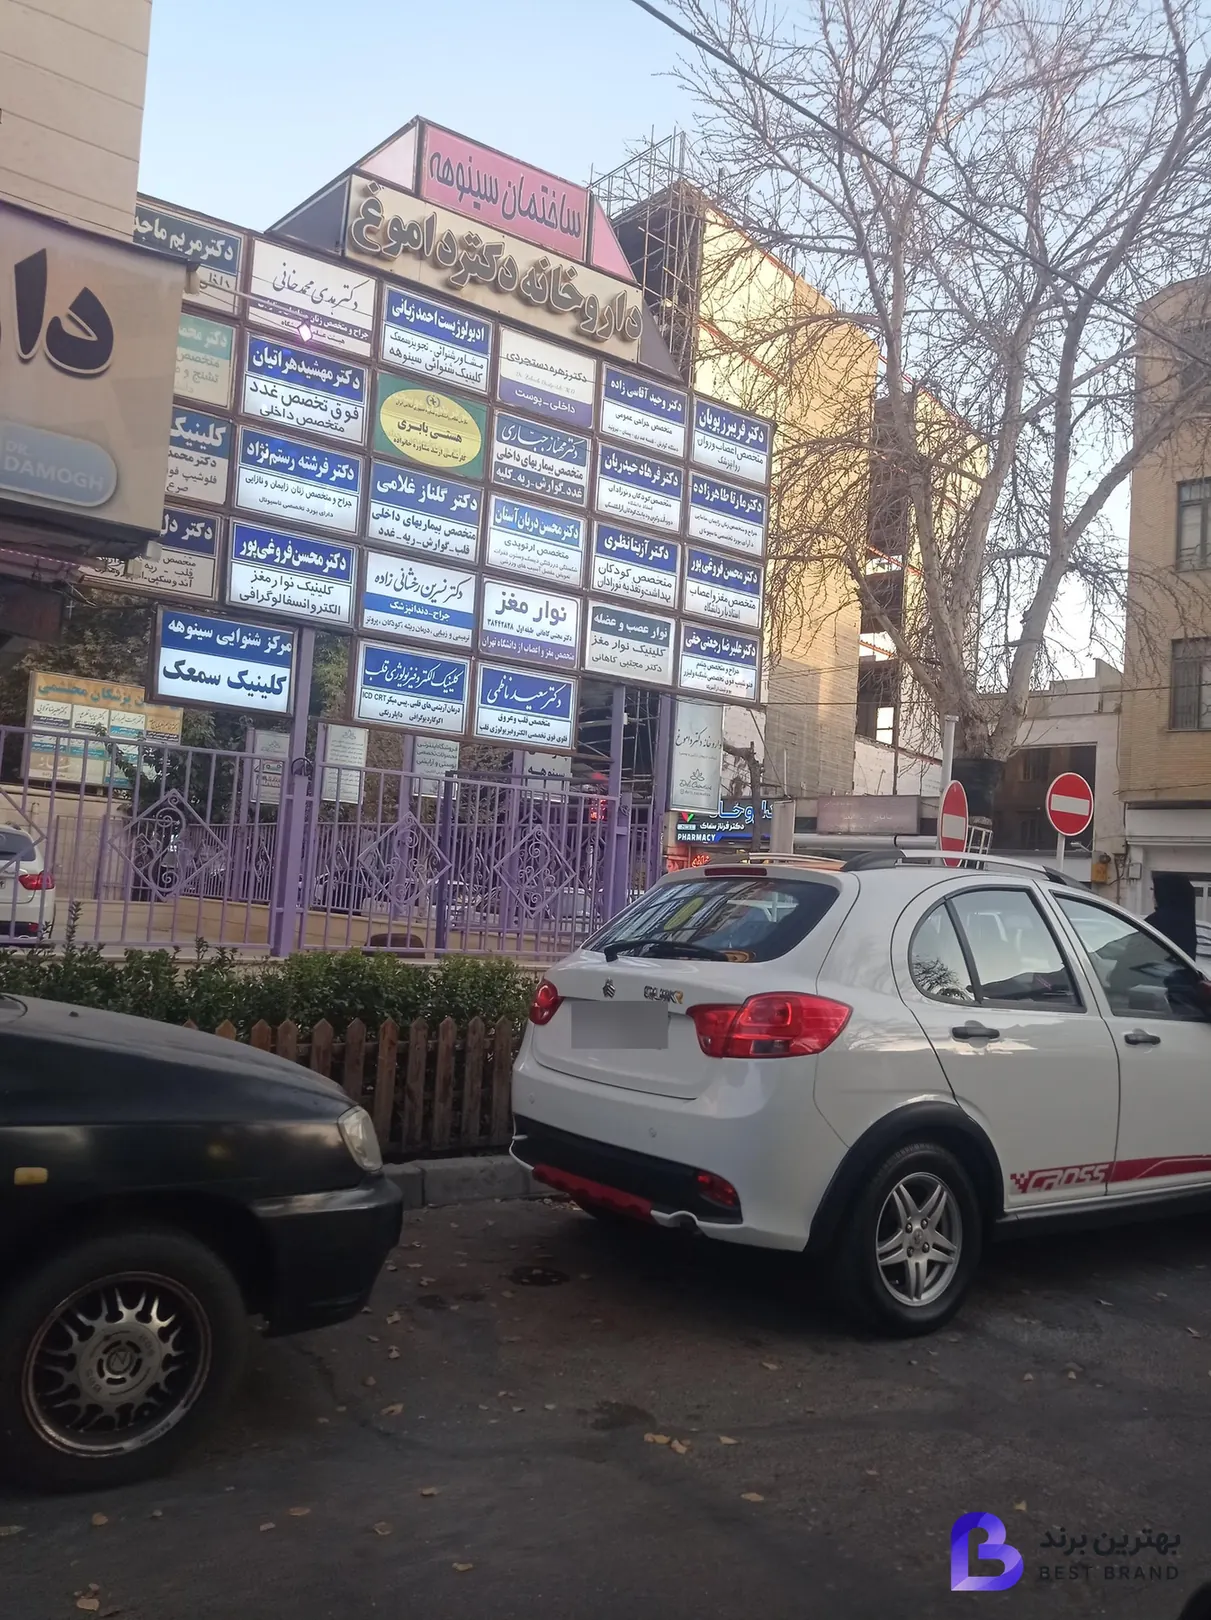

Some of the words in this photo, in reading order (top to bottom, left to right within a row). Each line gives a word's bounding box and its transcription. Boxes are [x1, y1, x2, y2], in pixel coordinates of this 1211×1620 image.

[429, 150, 500, 211] سینوهه
[501, 172, 581, 238] ساختمان
[352, 181, 459, 265] داموغ
[450, 232, 519, 290] دکتر
[330, 279, 371, 316] دکتر
[518, 255, 643, 341] داروخانه
[391, 298, 417, 322] ژیانی
[415, 307, 437, 325] احمد
[309, 313, 325, 326] زنان
[324, 320, 348, 332] متخصص
[353, 328, 369, 340] جراح
[437, 316, 484, 342] ادیولوژیست
[252, 347, 299, 374] هراتیان
[387, 346, 422, 366] سینوهه
[504, 352, 550, 371] دستجردی
[297, 360, 333, 382] مهشید
[424, 357, 454, 375] شنوائی
[548, 365, 569, 380] زهره
[331, 369, 360, 389] دکتر
[454, 367, 483, 384] کلینیک
[567, 371, 588, 383] دکتر
[249, 380, 278, 398] غدد
[610, 379, 626, 395] زاده
[280, 394, 328, 412] تخصص
[514, 389, 542, 406] پوست
[649, 393, 666, 410] وحید
[666, 399, 682, 412] دکتر
[259, 404, 294, 420] داخلی
[330, 402, 359, 423] فوق
[549, 400, 575, 413] داخلی
[295, 416, 345, 433] متخصص
[397, 419, 428, 436] بابری
[698, 407, 720, 433] پویان
[718, 416, 746, 440] فریبرز
[169, 416, 227, 448] کلینیک
[429, 429, 462, 443] هستی
[744, 425, 764, 444] دکتر
[193, 455, 217, 468] دکتر
[496, 447, 522, 463] داخلی
[520, 454, 554, 472] بیماریهای
[604, 452, 638, 475] حیدریان
[3, 456, 105, 493] DAMOGH
[244, 474, 264, 485] نازایی
[495, 466, 514, 480] کلیه
[516, 473, 530, 488] ریه
[553, 467, 583, 480] متخصص
[638, 462, 660, 483] فرهاد
[659, 471, 678, 487] دکتر
[165, 481, 188, 494] صرع
[269, 479, 289, 492] زایمان
[290, 485, 304, 496] زنان
[376, 474, 415, 494] غلامی
[534, 476, 563, 495] گوارش
[565, 486, 582, 498] غدد
[258, 496, 282, 506] ناسیونال
[305, 491, 331, 502] متخصص
[417, 483, 448, 503] گلناز
[281, 499, 305, 514] تخصصی
[336, 497, 352, 508] جراح
[449, 493, 477, 511] دکتر
[305, 507, 320, 516] بورد
[318, 510, 334, 518] دارای
[371, 507, 400, 522] داخلی
[492, 501, 520, 528] آستان
[377, 526, 395, 537] غدد
[402, 514, 442, 534] بیماریهای
[538, 521, 562, 535] محسن
[402, 532, 415, 546] ریه
[443, 527, 477, 544] متخصص
[559, 524, 580, 543] دکتر
[454, 544, 470, 556] قلب
[503, 539, 535, 552] ارتوپدی
[604, 534, 632, 551] نظری
[630, 537, 651, 560] آزیتا
[162, 555, 196, 567] متخصص
[290, 549, 323, 566] محسن
[536, 548, 569, 560] متخصص
[648, 545, 669, 560] دکتر
[143, 562, 157, 574] ریه
[321, 552, 346, 573] دکتر
[597, 562, 632, 580] کودکان
[173, 567, 194, 580] قلب
[250, 569, 271, 583] مغز
[374, 571, 393, 587] زاده
[391, 567, 422, 594] رخشانی
[632, 575, 672, 588] متخصص
[270, 575, 294, 591] نوار
[296, 580, 334, 597] کلینیک
[418, 578, 448, 603] نسرین
[441, 576, 472, 603] دکتر
[494, 591, 528, 615] مغز
[532, 600, 567, 626] نوار
[593, 613, 616, 626] عضله
[167, 620, 213, 640] سینوهه
[616, 619, 625, 633] و
[625, 623, 649, 634] عصب
[649, 626, 667, 641] نوار
[215, 628, 261, 649] شنوایی
[263, 635, 292, 655] مرکز
[590, 634, 609, 646] مغز
[611, 639, 629, 653] نوار
[591, 653, 618, 663] کاهانی
[631, 644, 666, 658] کلینیک
[162, 659, 221, 685] سمعک
[363, 655, 391, 682] قلب
[618, 659, 643, 669] مجتبی
[644, 663, 662, 673] دکتر
[227, 669, 288, 698] کلینیک
[429, 664, 465, 696] کلینیک
[509, 689, 550, 710] سعید
[538, 683, 566, 710] دکتر
[728, 821, 744, 831] دکتر
[677, 832, 716, 841] PHARMACY
[1027, 1163, 1110, 1193] CROSS
